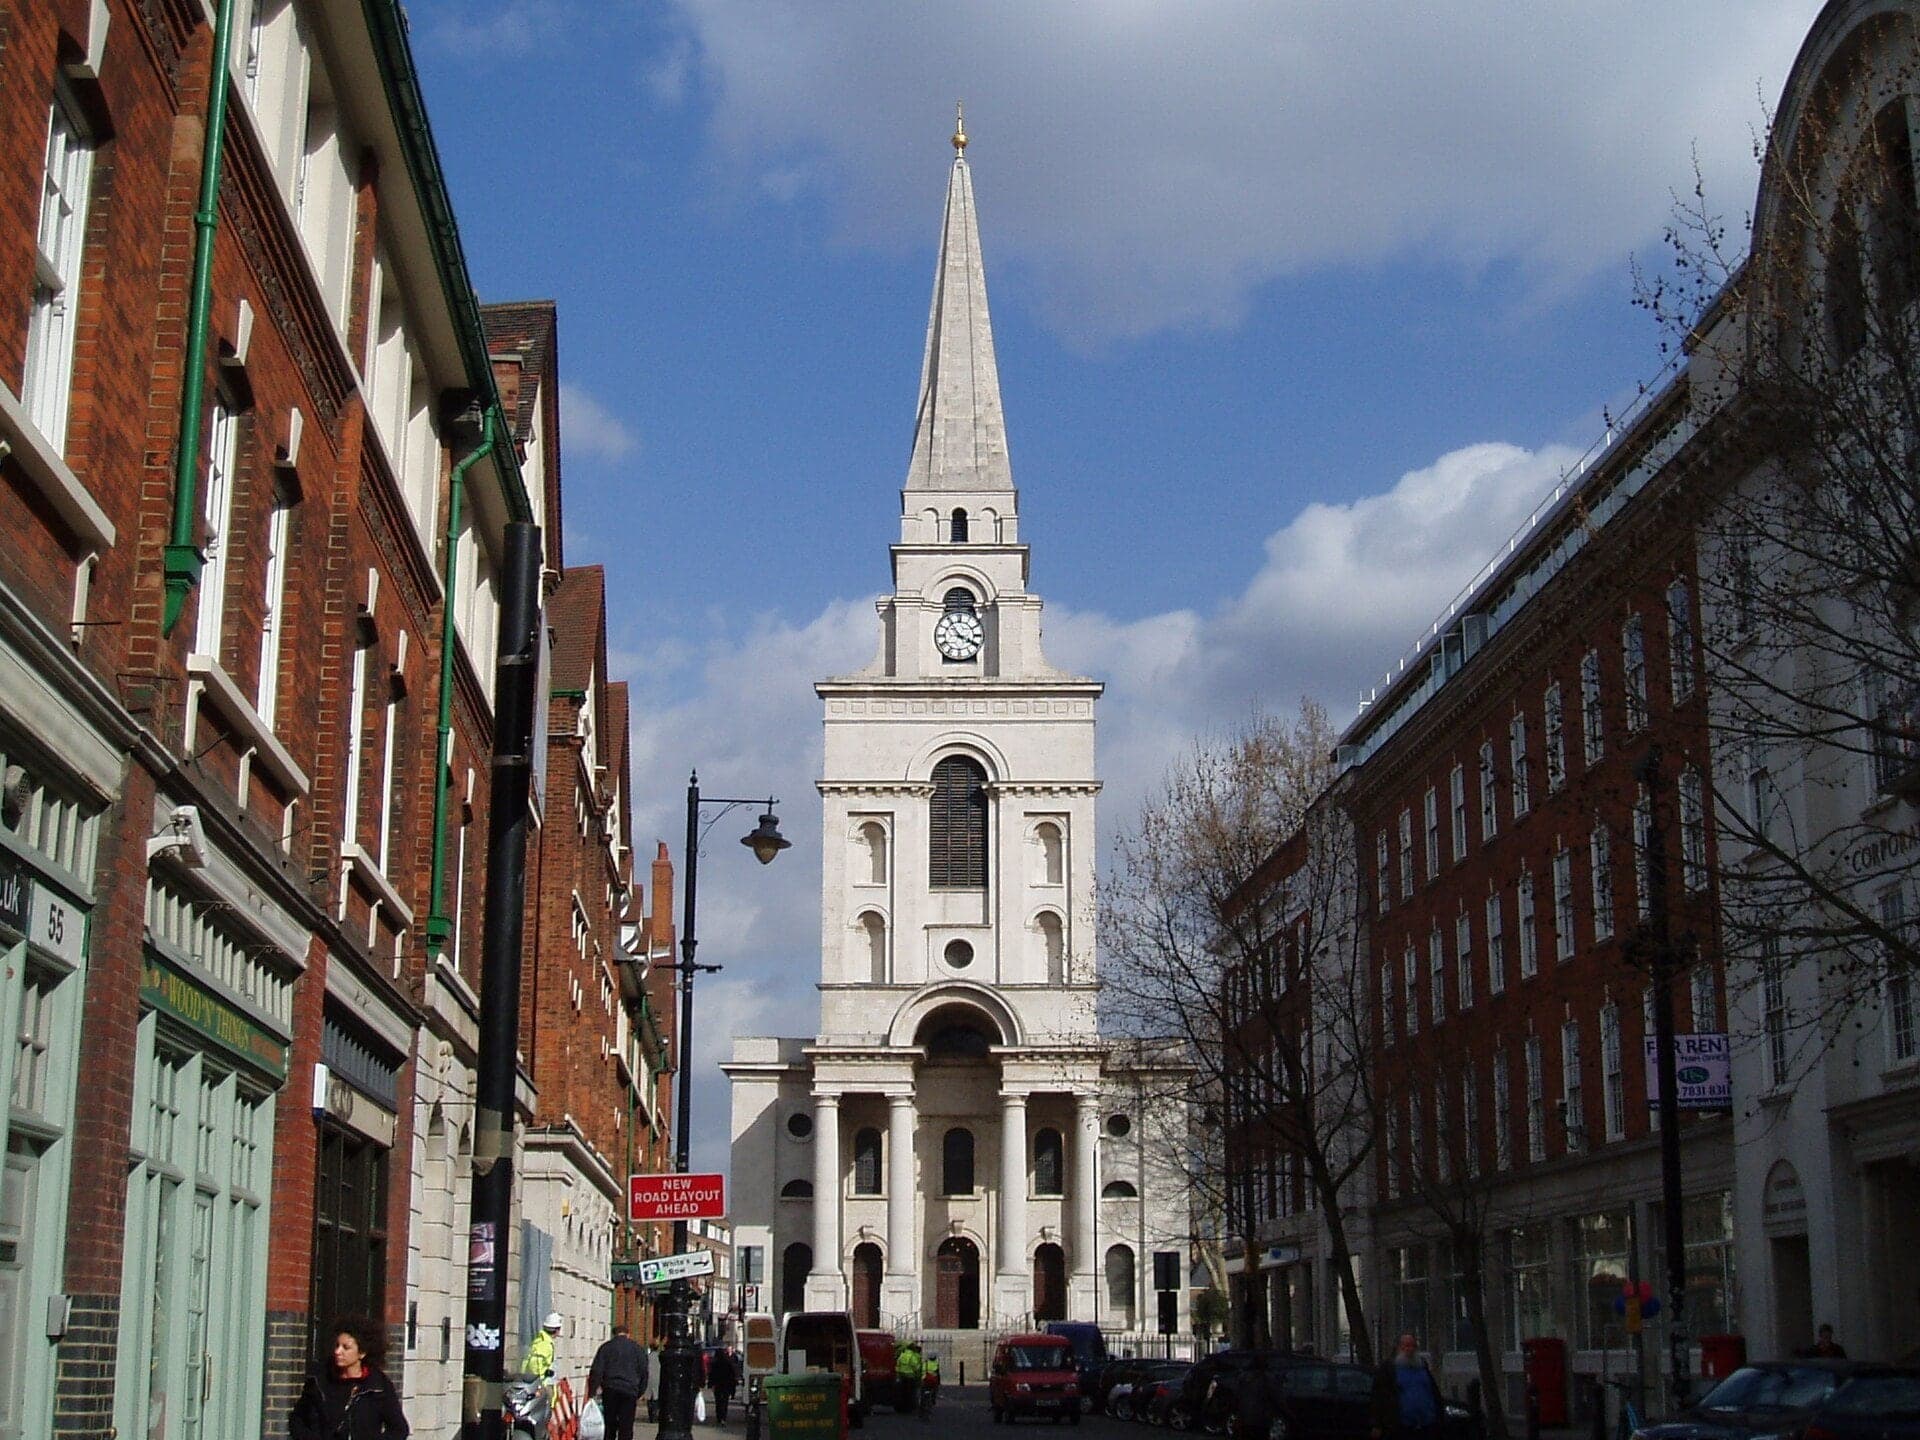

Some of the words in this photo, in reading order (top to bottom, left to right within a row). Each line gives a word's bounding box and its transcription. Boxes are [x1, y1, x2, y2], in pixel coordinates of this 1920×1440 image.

[1853, 824, 1920, 873] CORPORA
[48, 903, 64, 945] 55
[169, 973, 201, 1021] WOOD
[1646, 1039, 1682, 1056] FR
[662, 1179, 692, 1190] NEW
[634, 1191, 670, 1203] ROAD
[673, 1190, 720, 1202] LAYOUT
[655, 1203, 699, 1214] AHEAD
[662, 1258, 690, 1268] White's
